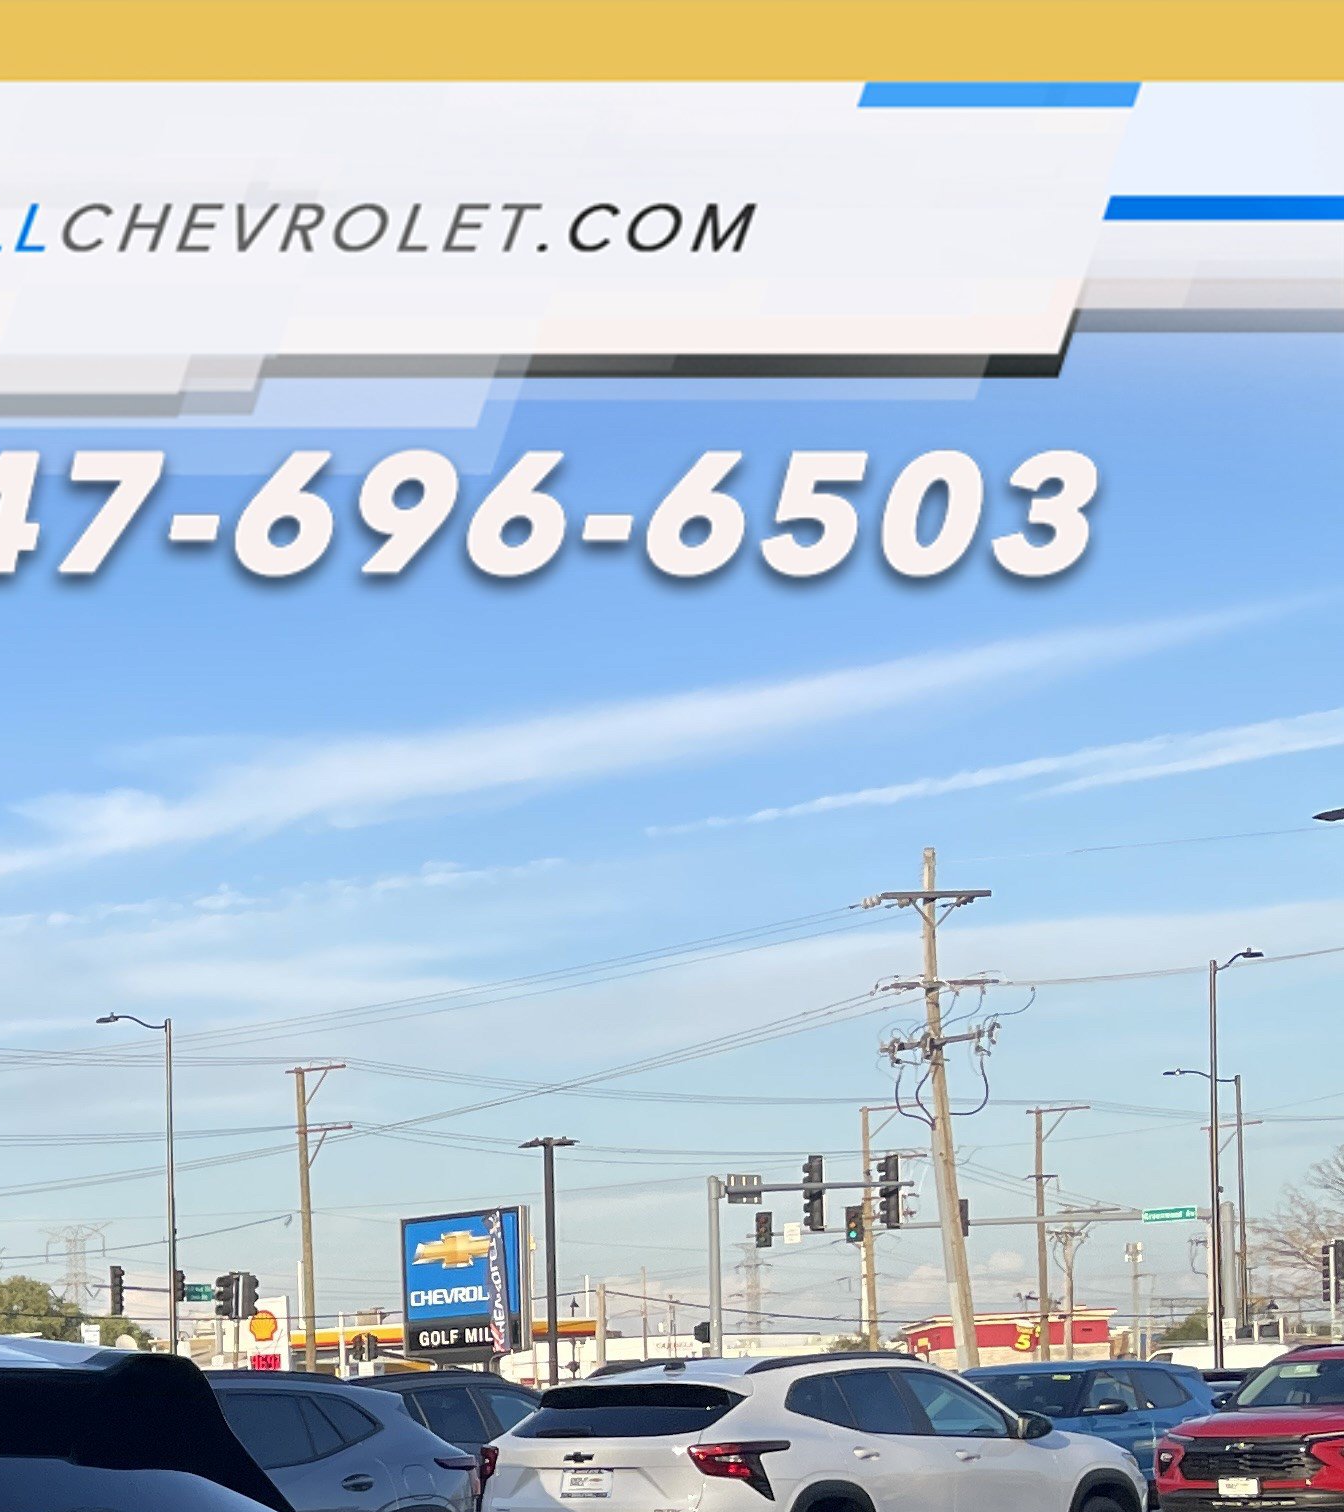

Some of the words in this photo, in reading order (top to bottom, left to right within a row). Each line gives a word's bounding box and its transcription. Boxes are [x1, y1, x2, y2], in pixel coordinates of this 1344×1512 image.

[410, 1286, 490, 1307] CHEVROL
[419, 1330, 459, 1347] GOLF
[465, 1326, 496, 1343] MIL
